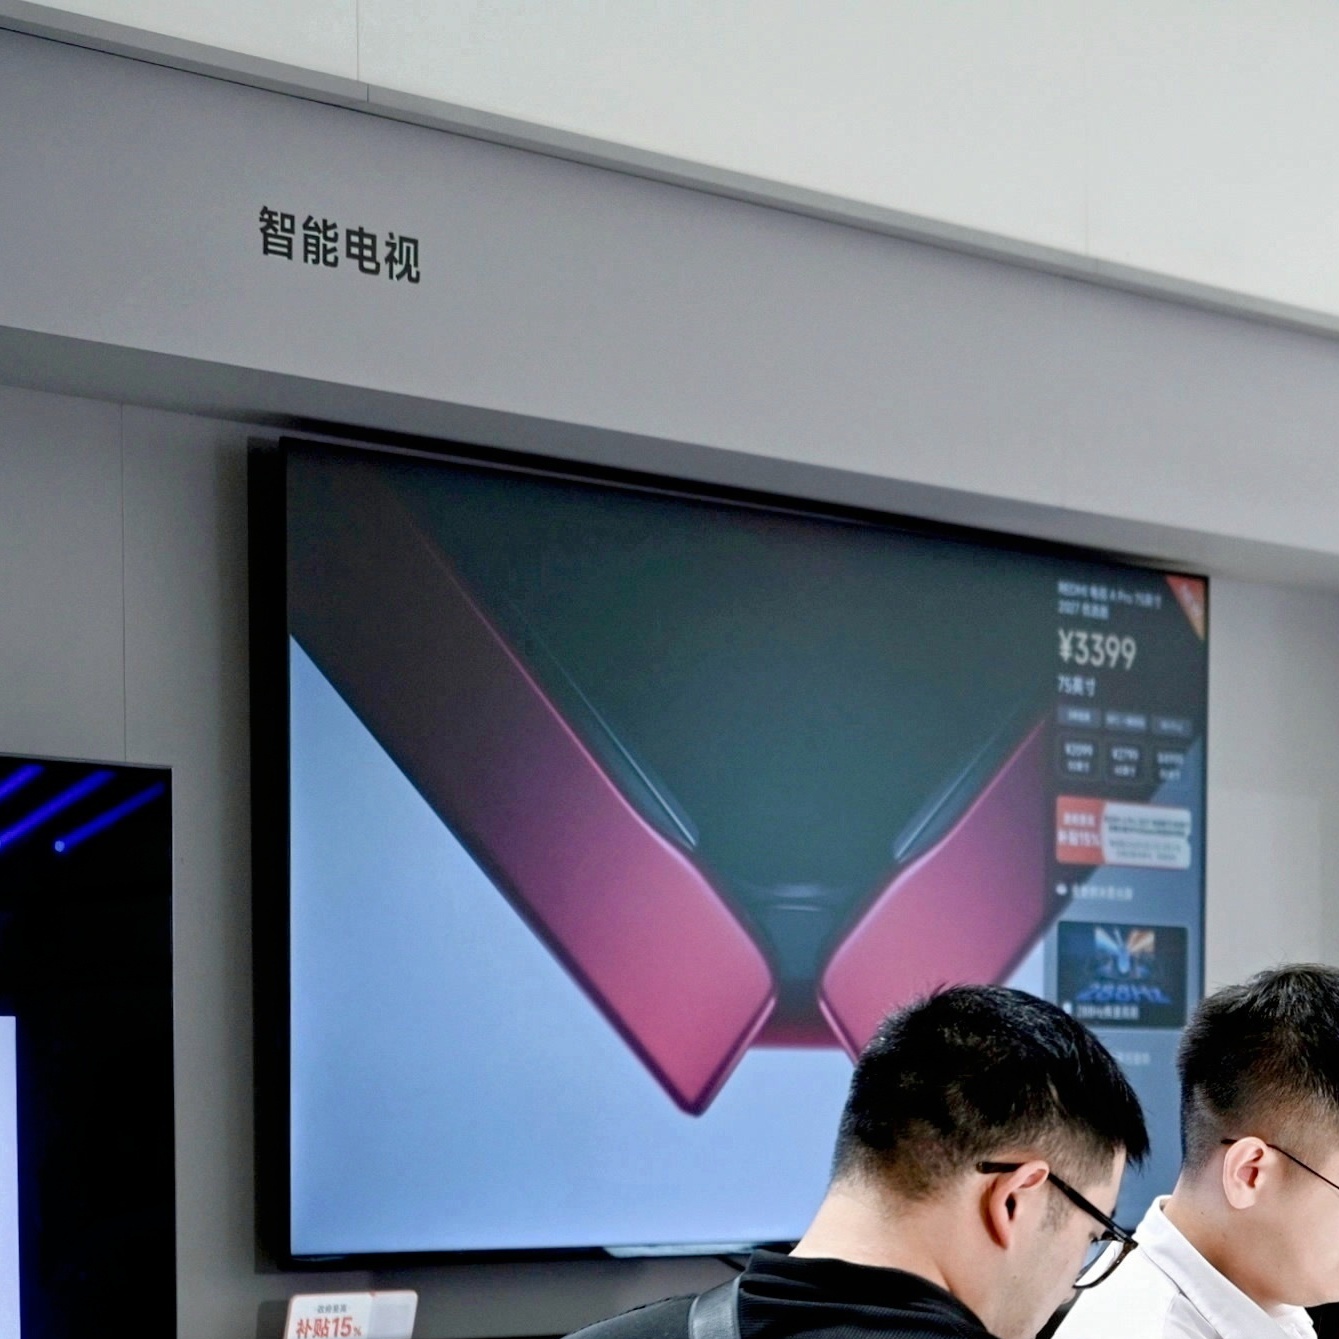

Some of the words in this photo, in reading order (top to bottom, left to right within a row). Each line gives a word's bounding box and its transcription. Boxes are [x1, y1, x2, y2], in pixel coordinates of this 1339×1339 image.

[258, 205, 421, 284] 智能电视
[1058, 628, 1137, 670] ¥3399
